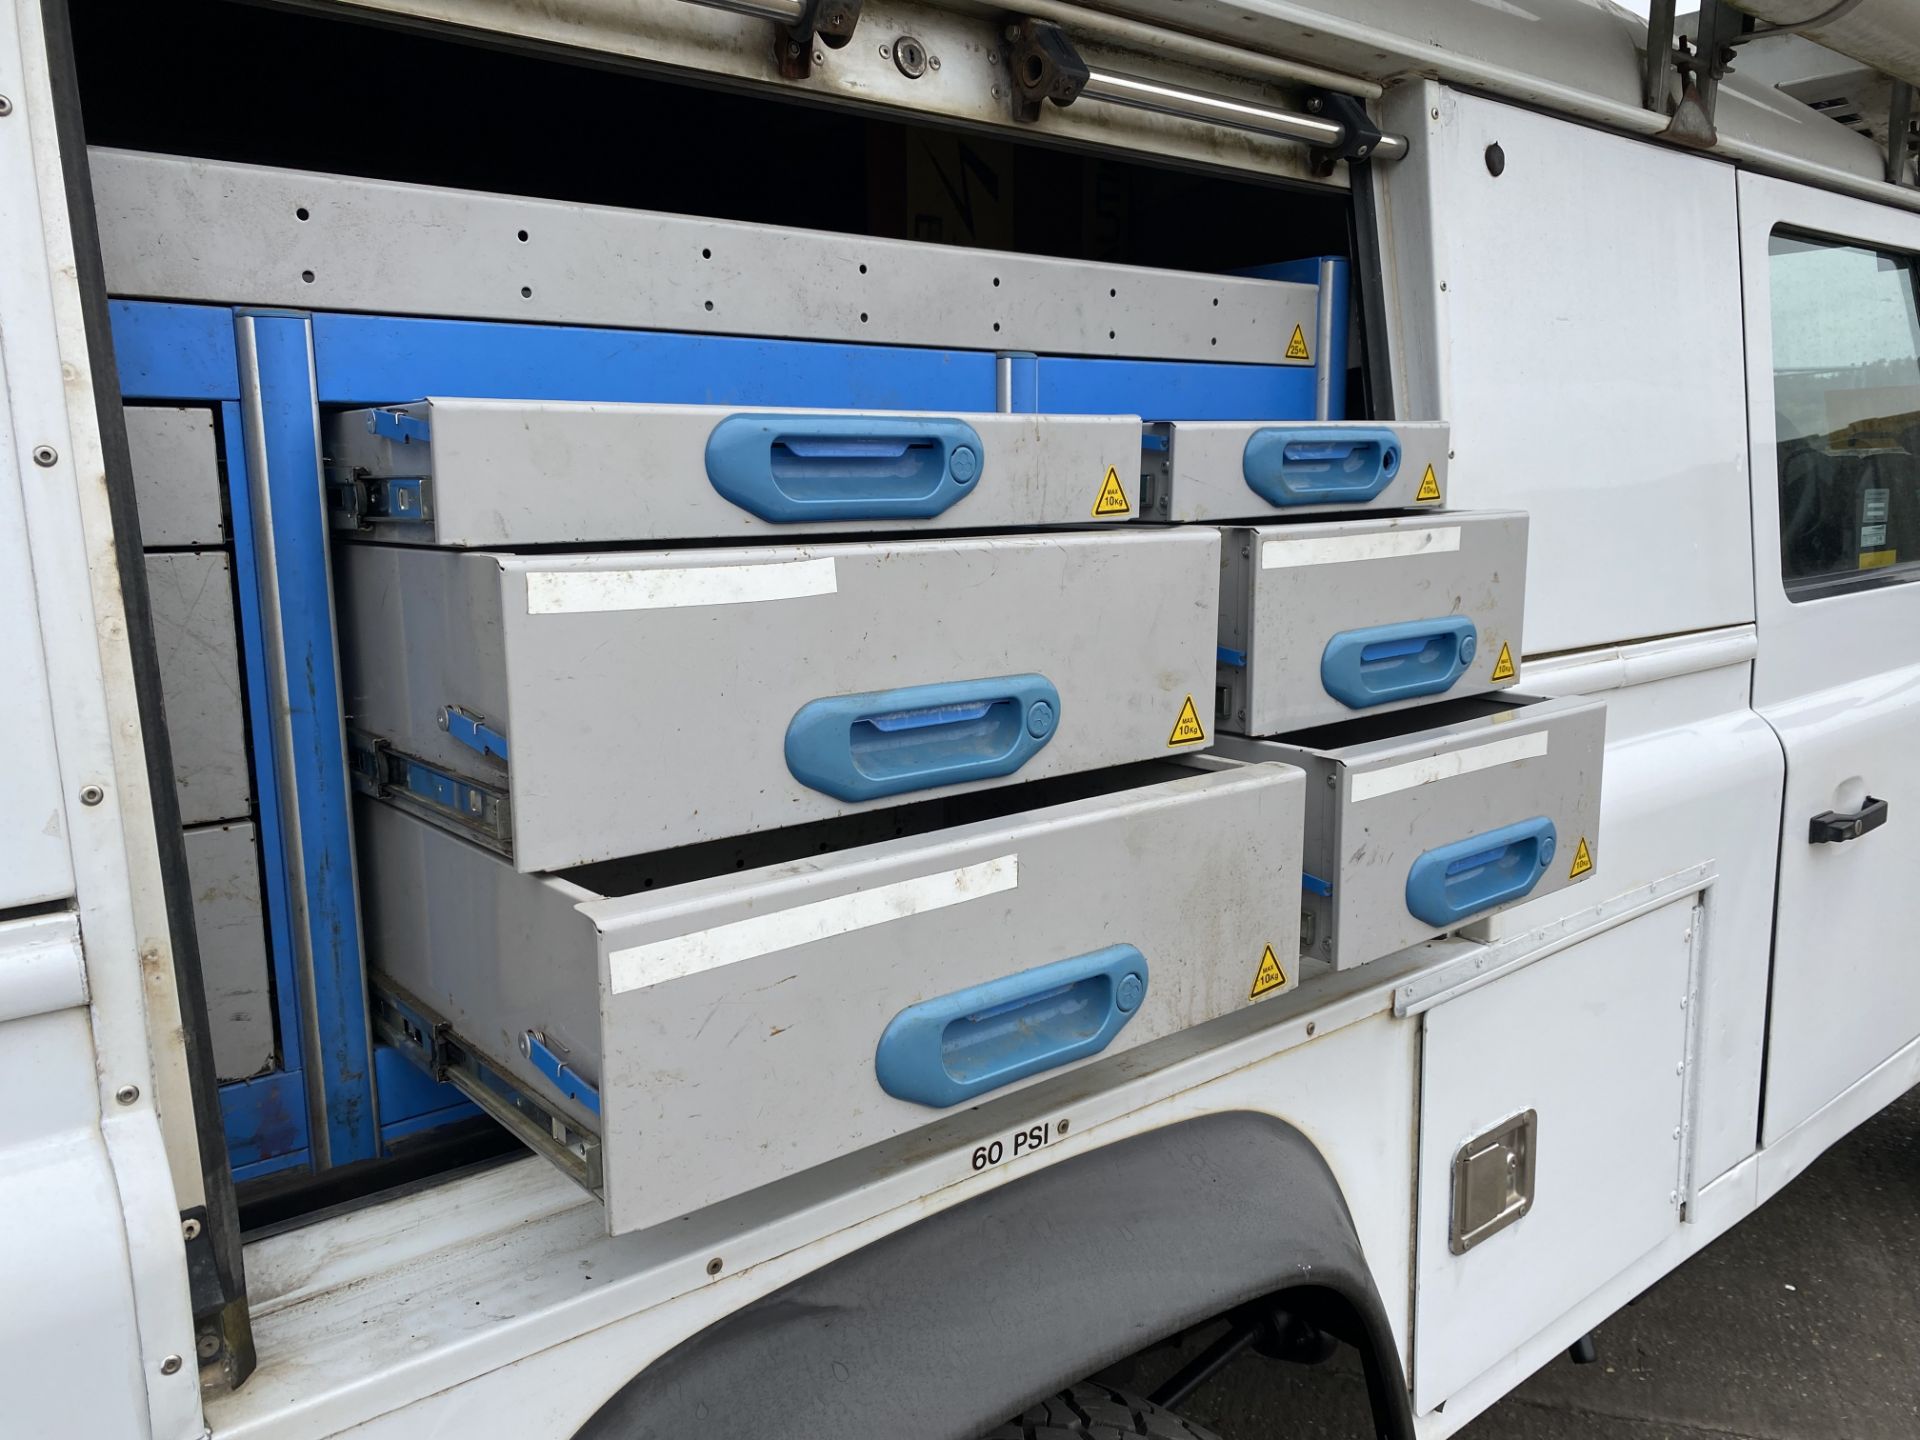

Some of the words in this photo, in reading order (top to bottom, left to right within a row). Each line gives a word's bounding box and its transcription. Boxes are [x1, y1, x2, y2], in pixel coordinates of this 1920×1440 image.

[1105, 496, 1123, 507] 10Kg
[1179, 725, 1198, 736] 10Kg
[1263, 965, 1274, 974] MAX
[1261, 974, 1279, 986] 10Kg
[972, 1141, 1003, 1171] 60
[1014, 1123, 1049, 1156] PSI
